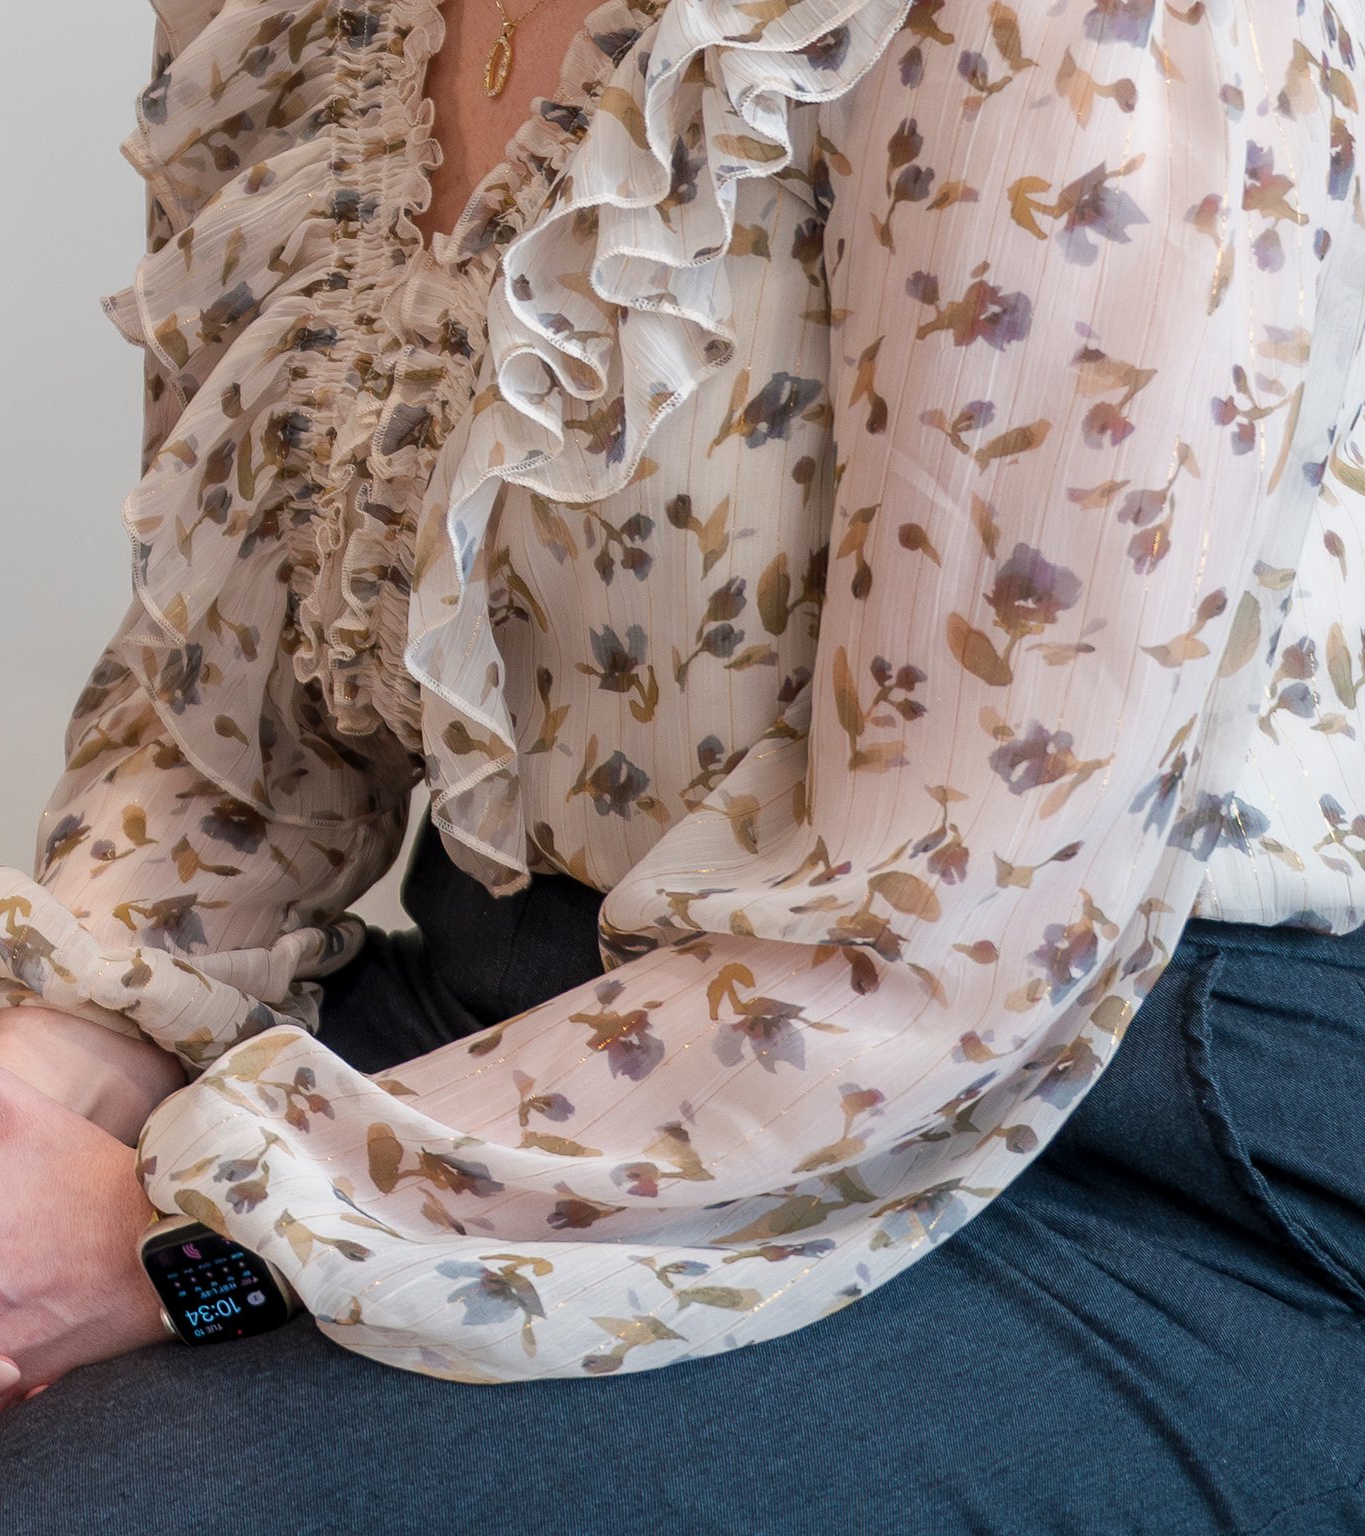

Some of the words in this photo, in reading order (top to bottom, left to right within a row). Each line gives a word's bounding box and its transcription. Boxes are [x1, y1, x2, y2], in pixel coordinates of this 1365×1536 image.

[185, 1297, 242, 1326] 10:34
[194, 1328, 205, 1338] 10
[205, 1324, 223, 1334] TUE
